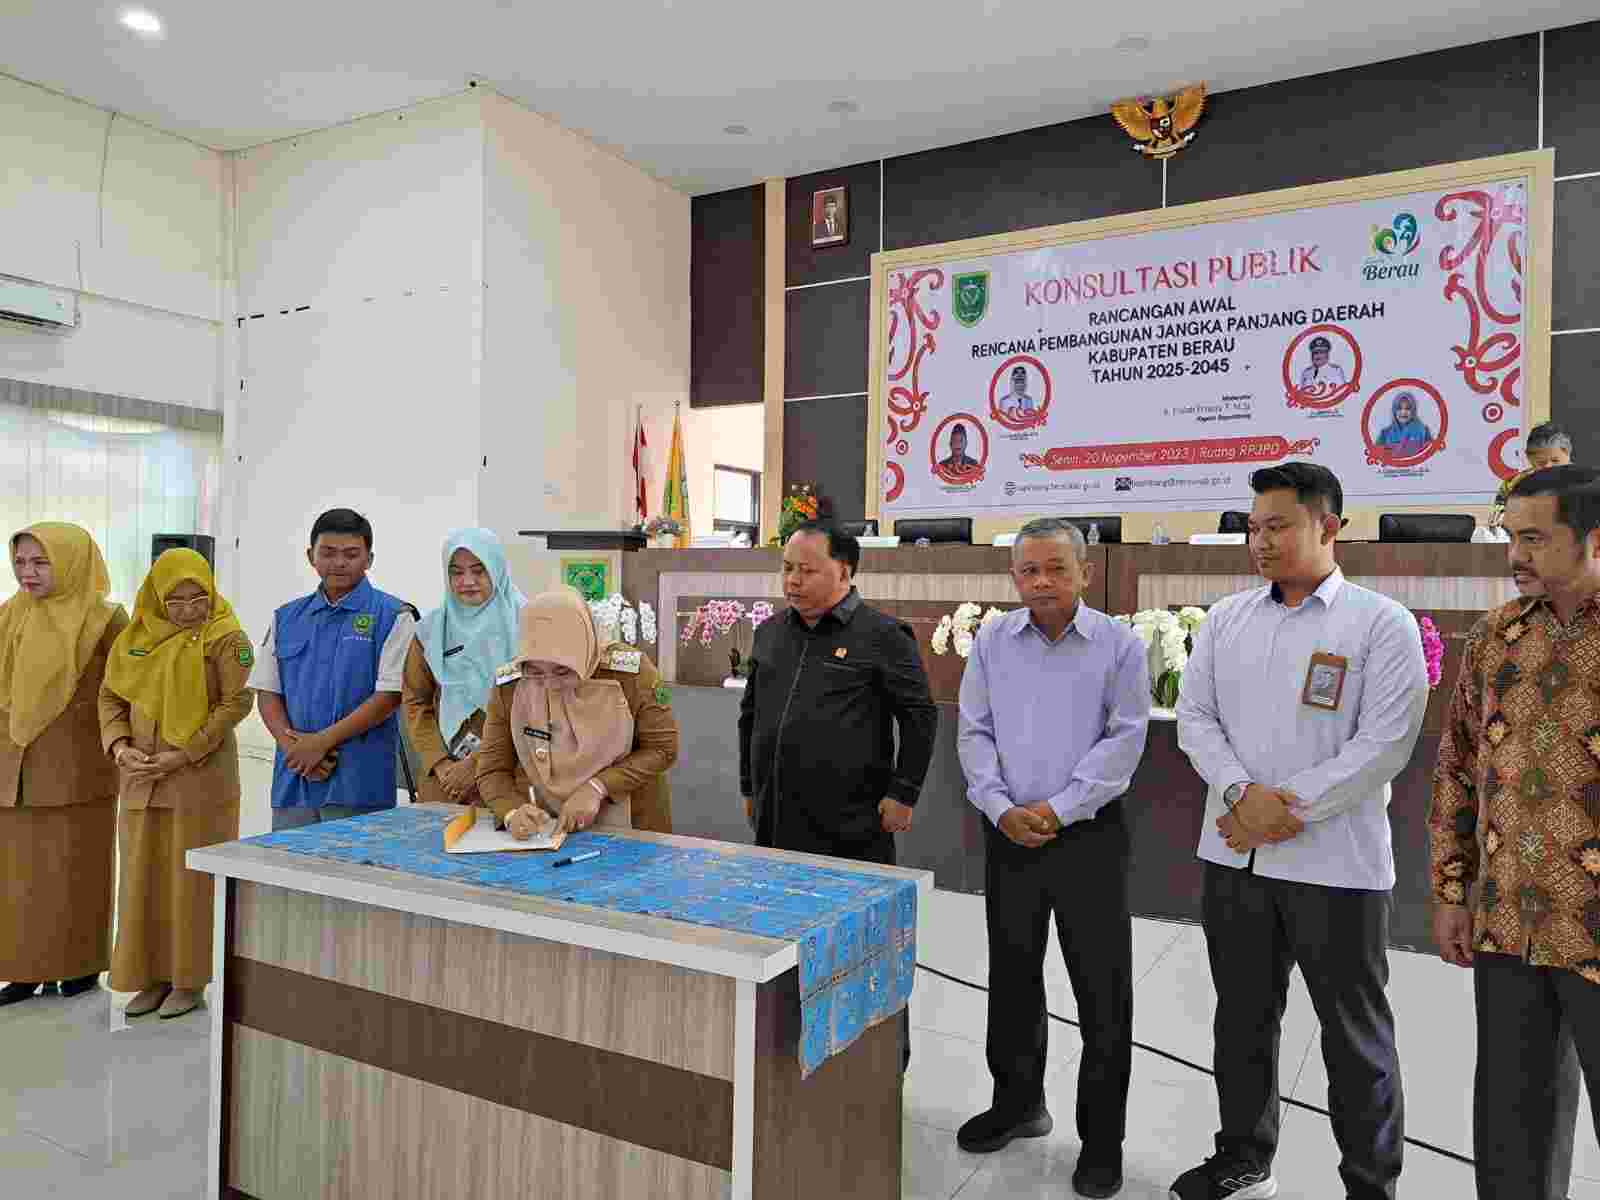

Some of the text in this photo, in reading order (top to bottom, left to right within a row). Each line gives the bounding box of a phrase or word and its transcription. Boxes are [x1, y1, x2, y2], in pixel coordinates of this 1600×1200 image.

[1024, 244, 1321, 305] KONSULTASI PUBLIK
[1362, 263, 1420, 280] Berau
[1089, 296, 1236, 326] RANCANGAN AWAL
[971, 302, 1385, 358] RENCANA PEMBANGUNAN JANGKA PANJANG DAERAH
[1088, 337, 1235, 365] KABUPATEN BERAU
[1092, 358, 1230, 384] TAHUN 2025-2045
[1085, 452, 1098, 464] 20
[1160, 446, 1188, 460] 2023
[1200, 445, 1236, 460] Ruang
